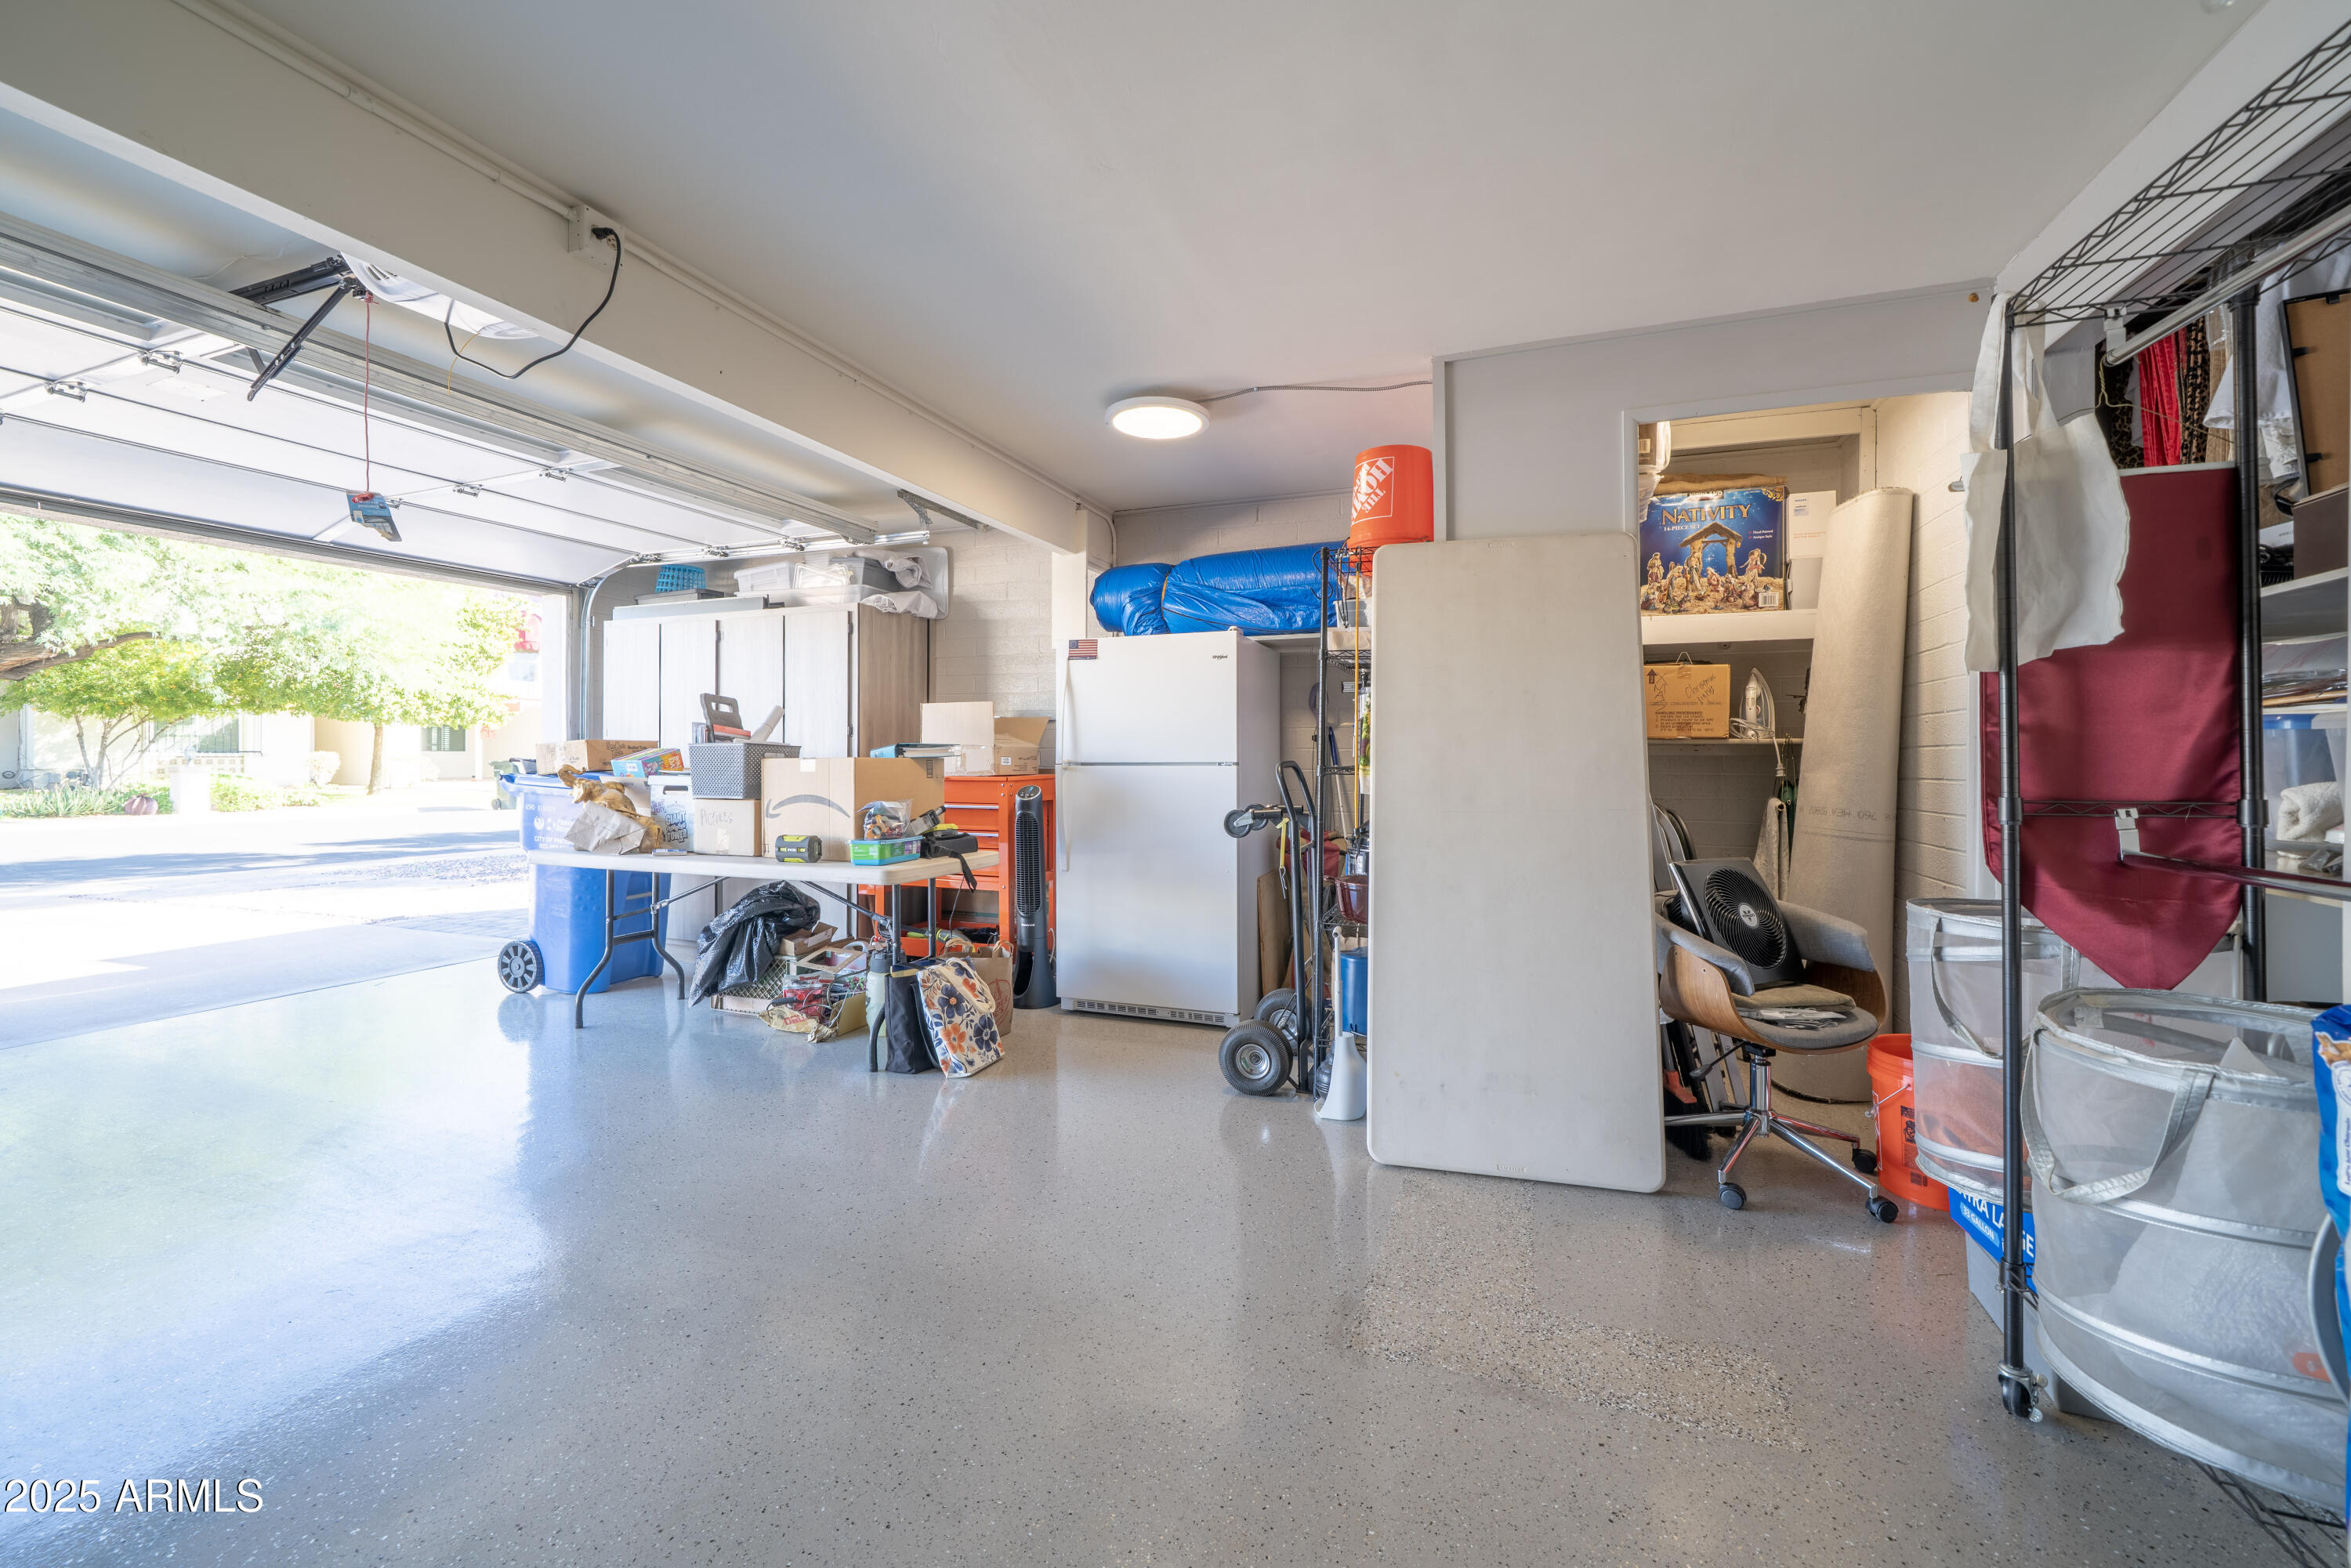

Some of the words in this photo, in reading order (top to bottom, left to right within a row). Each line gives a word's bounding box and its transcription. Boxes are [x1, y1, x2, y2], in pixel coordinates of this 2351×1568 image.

[1362, 487, 1386, 513] THE
[1661, 504, 1751, 525] NATIVITY
[665, 810, 686, 825] GIANT
[667, 829, 688, 842] TOWER
[1962, 1205, 1970, 1216] 33
[1971, 1213, 1994, 1240] GALLON
